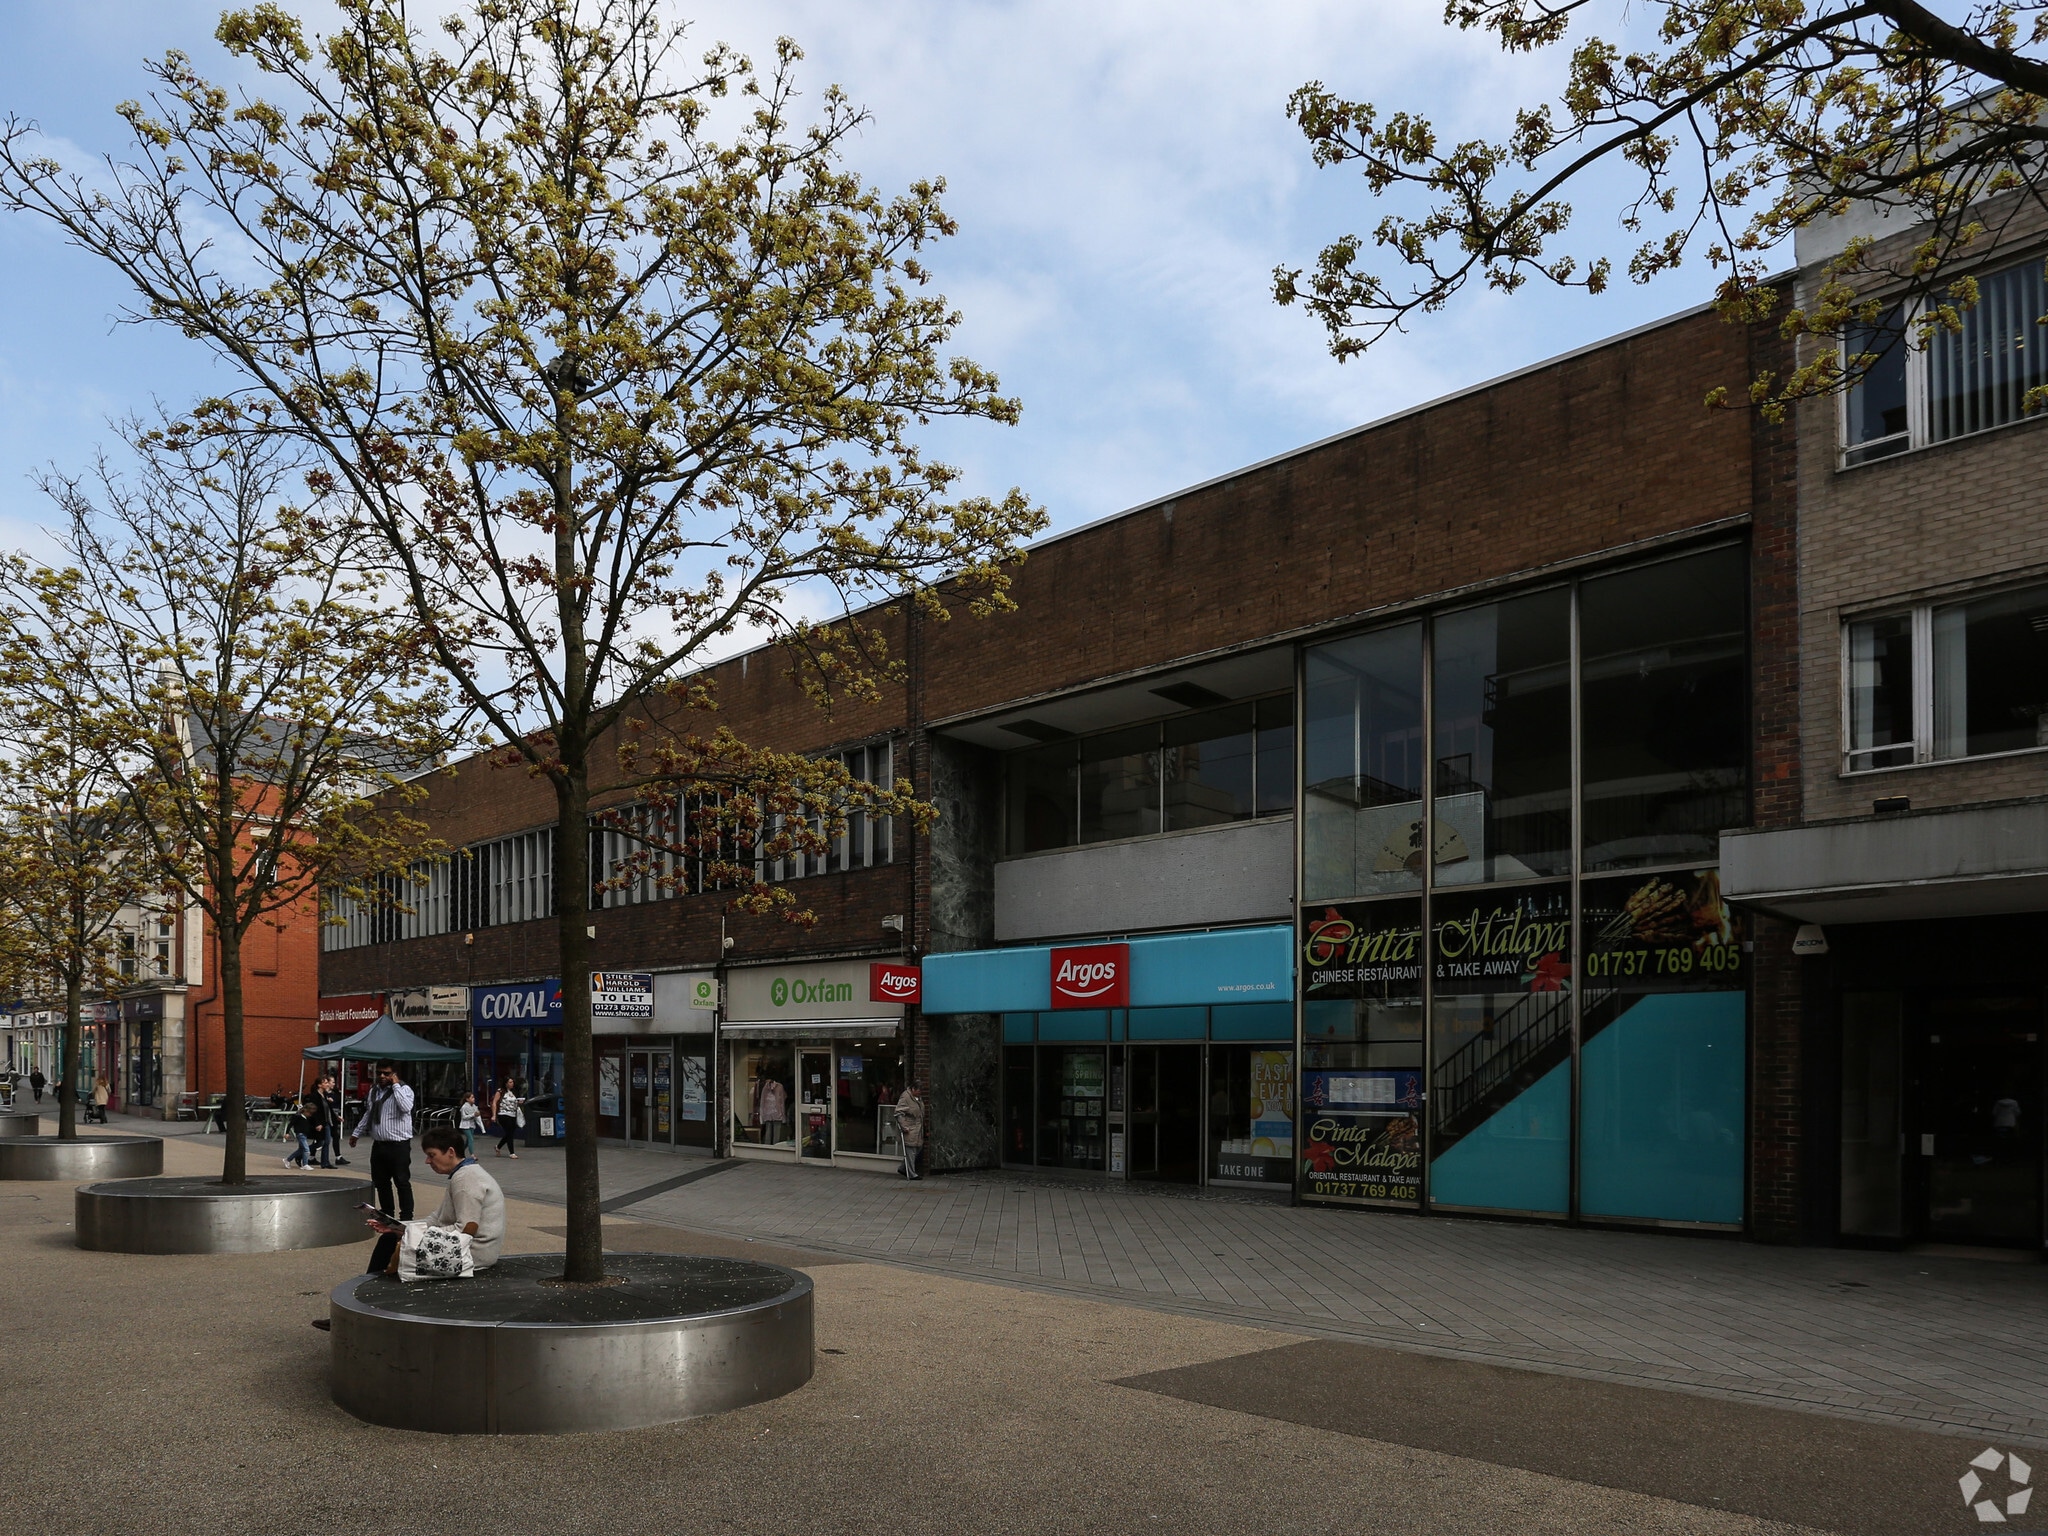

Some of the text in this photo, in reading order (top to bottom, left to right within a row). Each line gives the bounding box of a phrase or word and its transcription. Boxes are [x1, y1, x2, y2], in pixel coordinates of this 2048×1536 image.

[1306, 906, 1572, 970] Cinta Malaya
[1587, 945, 1741, 977] 01737 769 405
[1056, 959, 1116, 988] Argos
[1312, 960, 1520, 983] CHINESE RESTAURANT & TAKE AWAY
[791, 977, 853, 1004] Oxfam
[880, 972, 917, 991] Argos
[1217, 982, 1276, 993] www.argos.co.uk
[480, 990, 548, 1020] CORAL
[600, 994, 645, 1003] TO LET
[692, 998, 715, 1007] Oxfam
[319, 1007, 379, 1021] British Heart Foundation
[594, 1010, 650, 1018] www.shw.co.uk
[1255, 1063, 1293, 1081] EAST
[1309, 1118, 1371, 1142] Cinta
[1333, 1142, 1421, 1175] Malaya
[1219, 1164, 1264, 1177] TAKE ONE
[1308, 1171, 1421, 1185] ORIENTAL RESTAURANT & TAKE AWA
[1315, 1181, 1417, 1199] 01737 769 405
